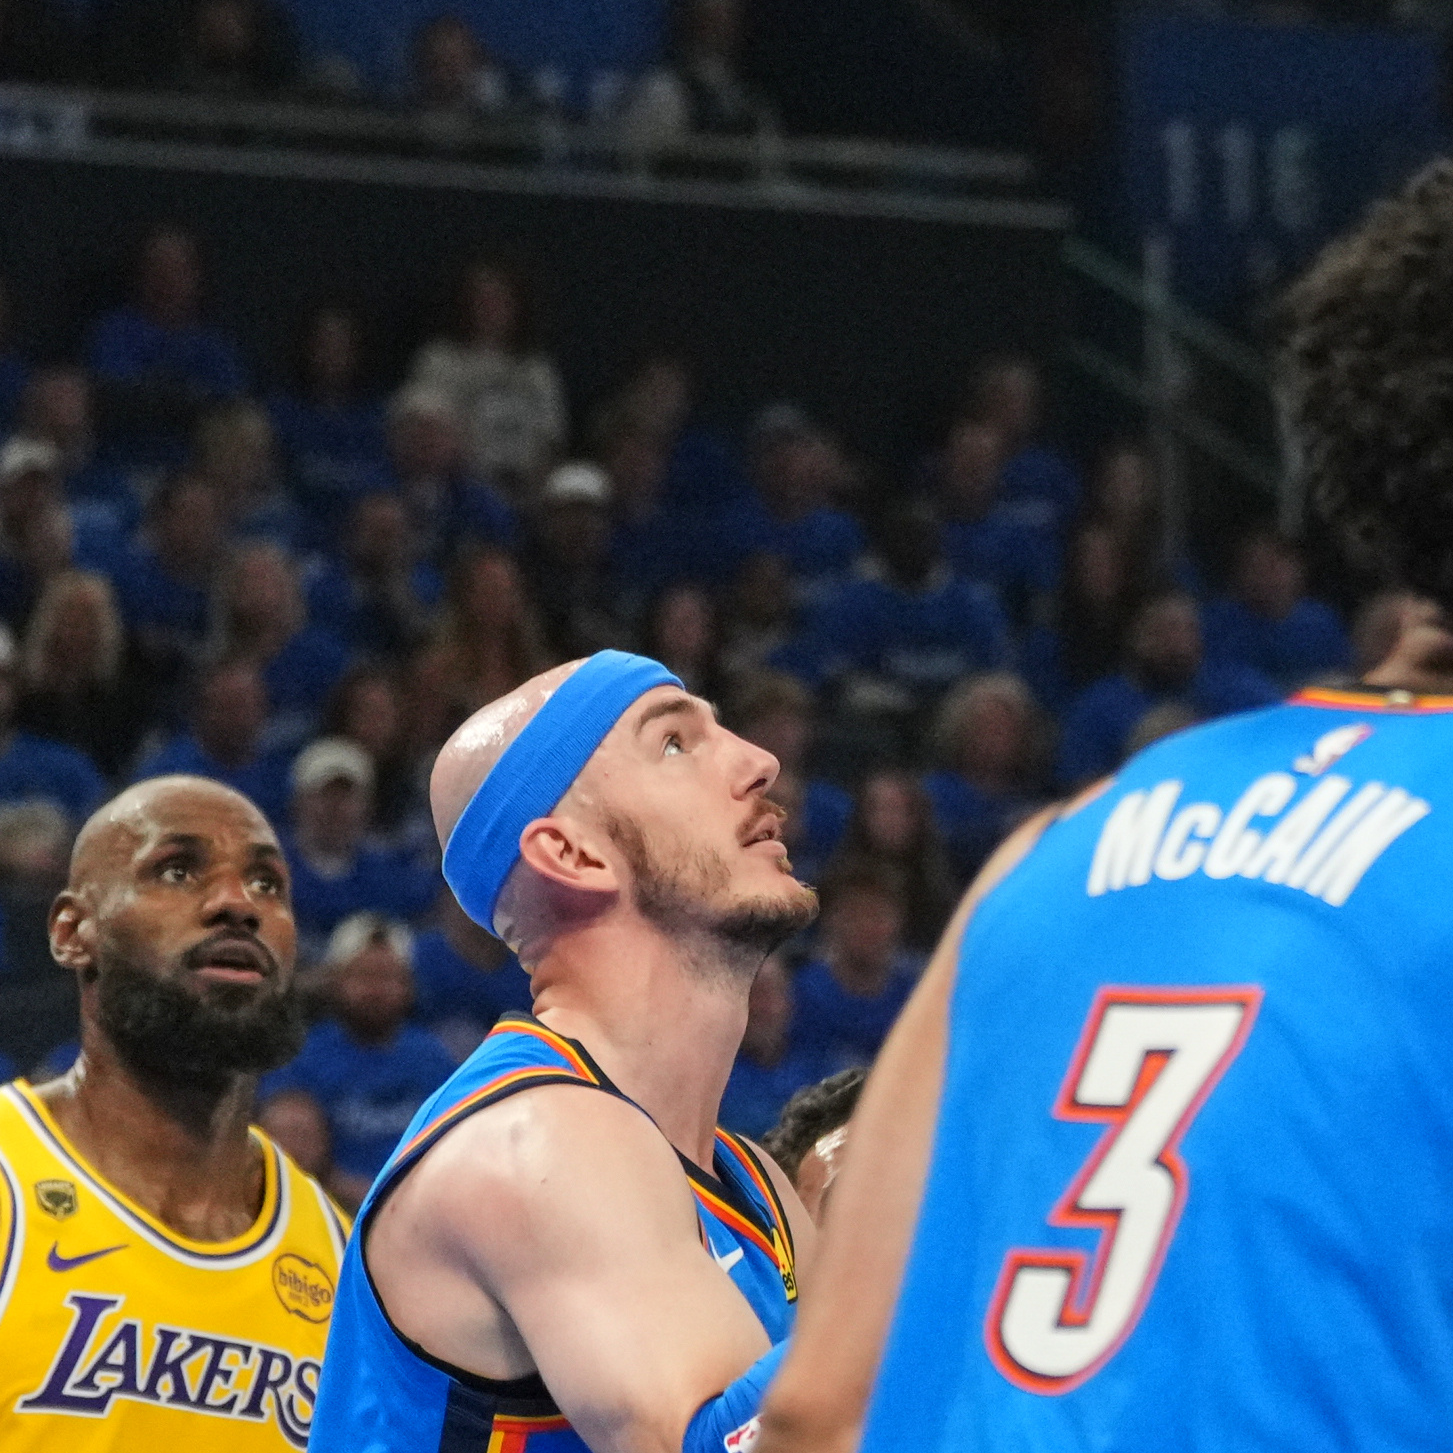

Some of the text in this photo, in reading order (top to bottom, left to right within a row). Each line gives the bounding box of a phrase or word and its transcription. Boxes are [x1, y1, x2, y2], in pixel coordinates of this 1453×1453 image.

[1086, 771, 1432, 907] McCAIN
[984, 985, 1264, 1396] 3
[13, 1290, 325, 1453] LAKERS
